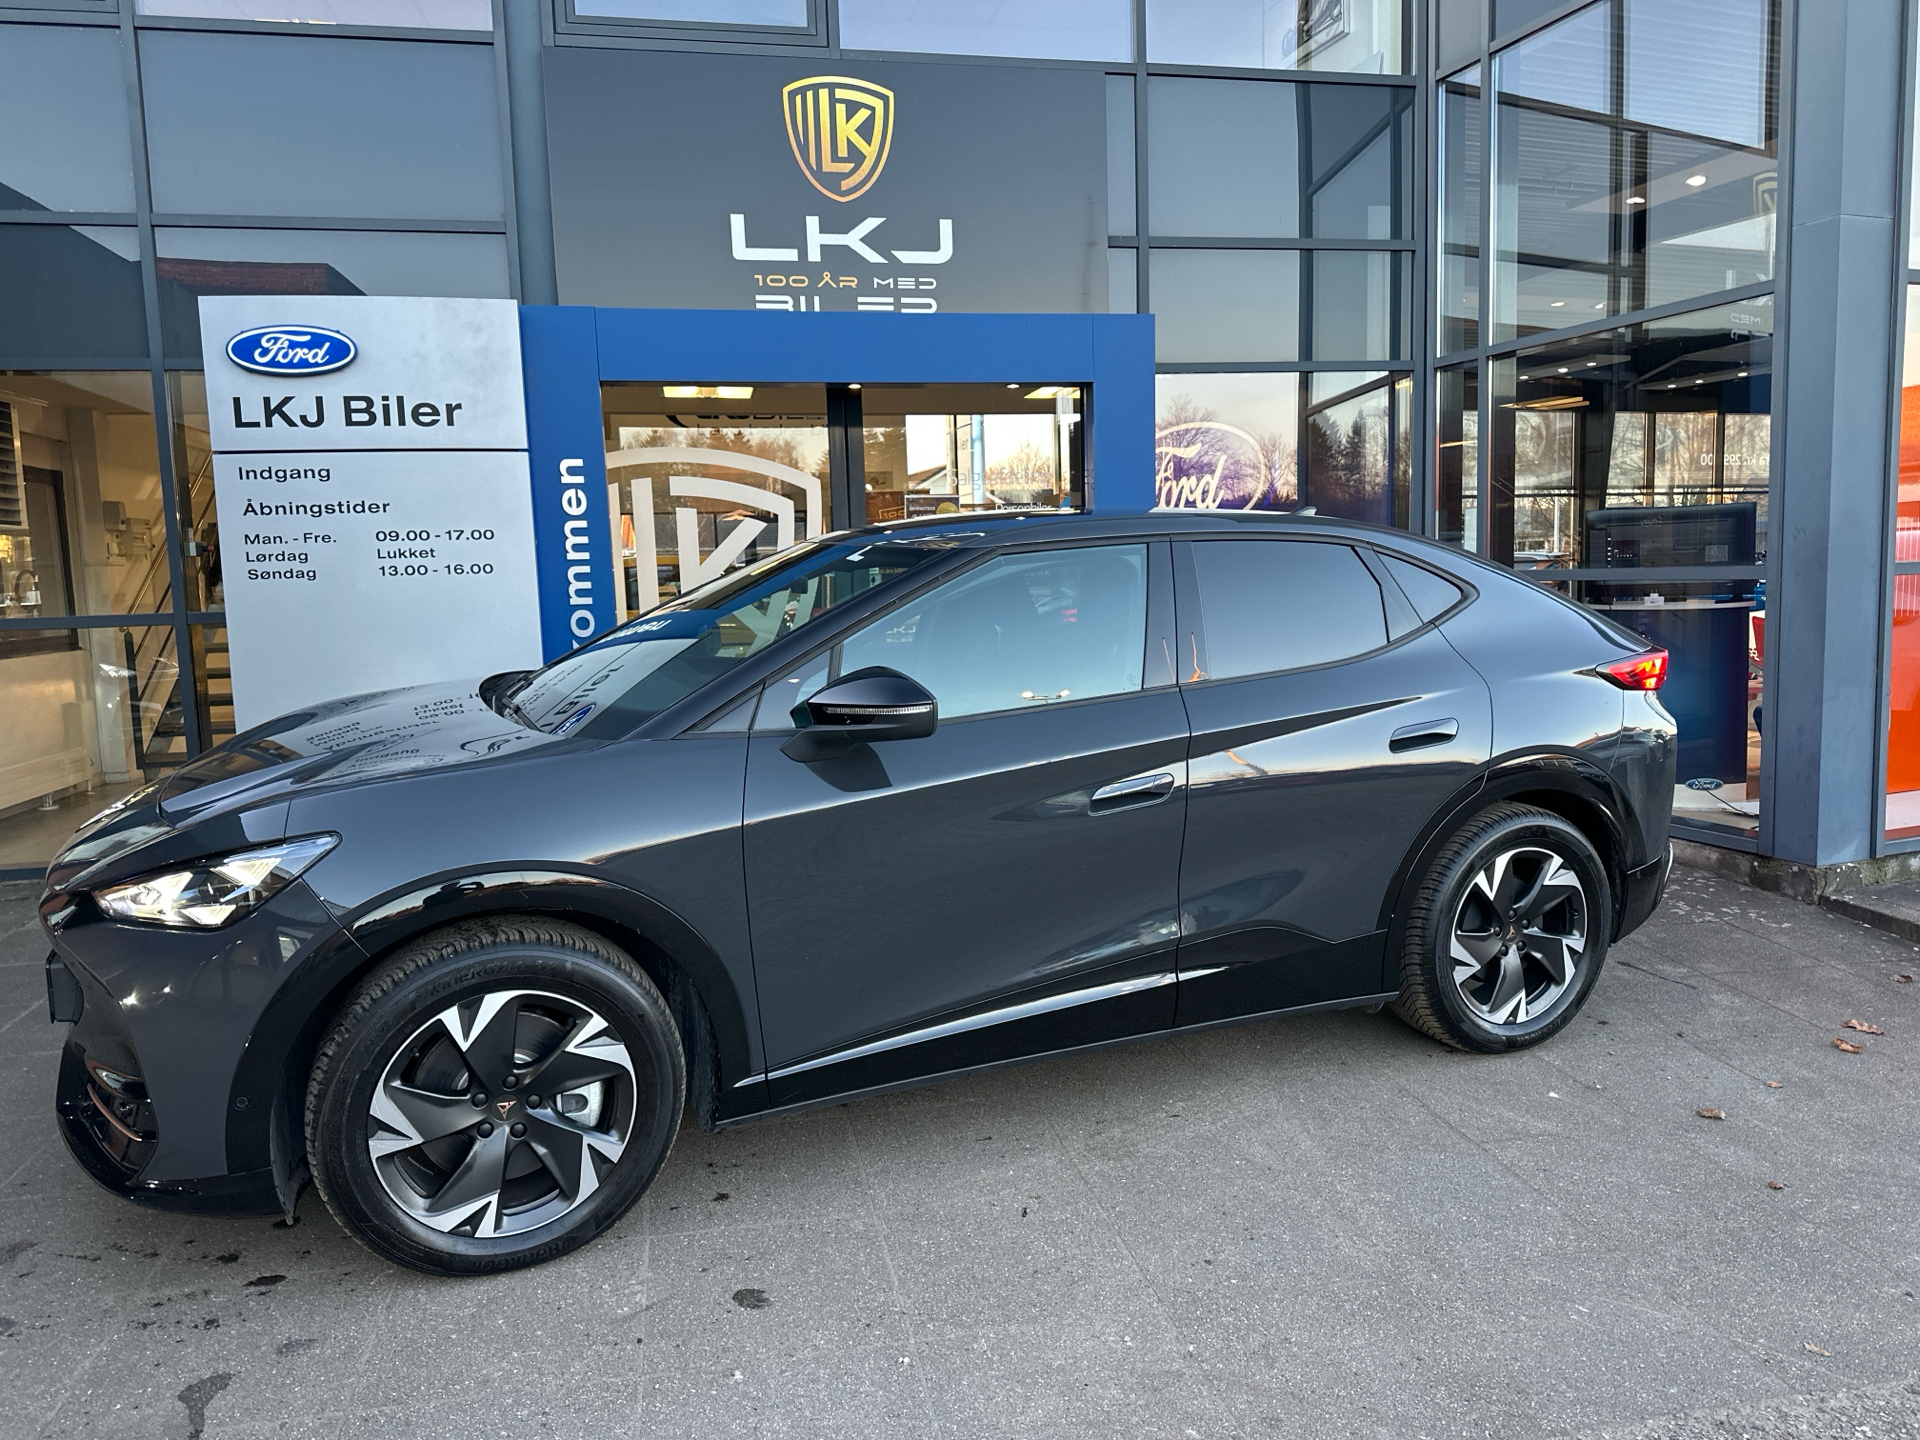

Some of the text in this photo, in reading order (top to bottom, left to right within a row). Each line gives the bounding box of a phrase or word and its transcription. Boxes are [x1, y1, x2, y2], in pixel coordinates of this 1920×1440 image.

[729, 213, 953, 264] LKJ
[754, 271, 937, 290] 100 ÅR MED
[253, 333, 332, 365] Ford
[232, 395, 463, 428] LKJ Biler
[238, 466, 331, 482] Indgang
[242, 498, 391, 518] Åbningstider
[244, 533, 289, 545] Man.
[303, 532, 338, 544] Fre.
[375, 530, 431, 542] 09.00
[444, 529, 495, 541] 17.00
[245, 551, 309, 564] Lørdag
[376, 548, 436, 560] Lukket
[247, 568, 317, 581] Søndag
[378, 565, 429, 577] 13.00
[443, 563, 494, 575] 16.00
